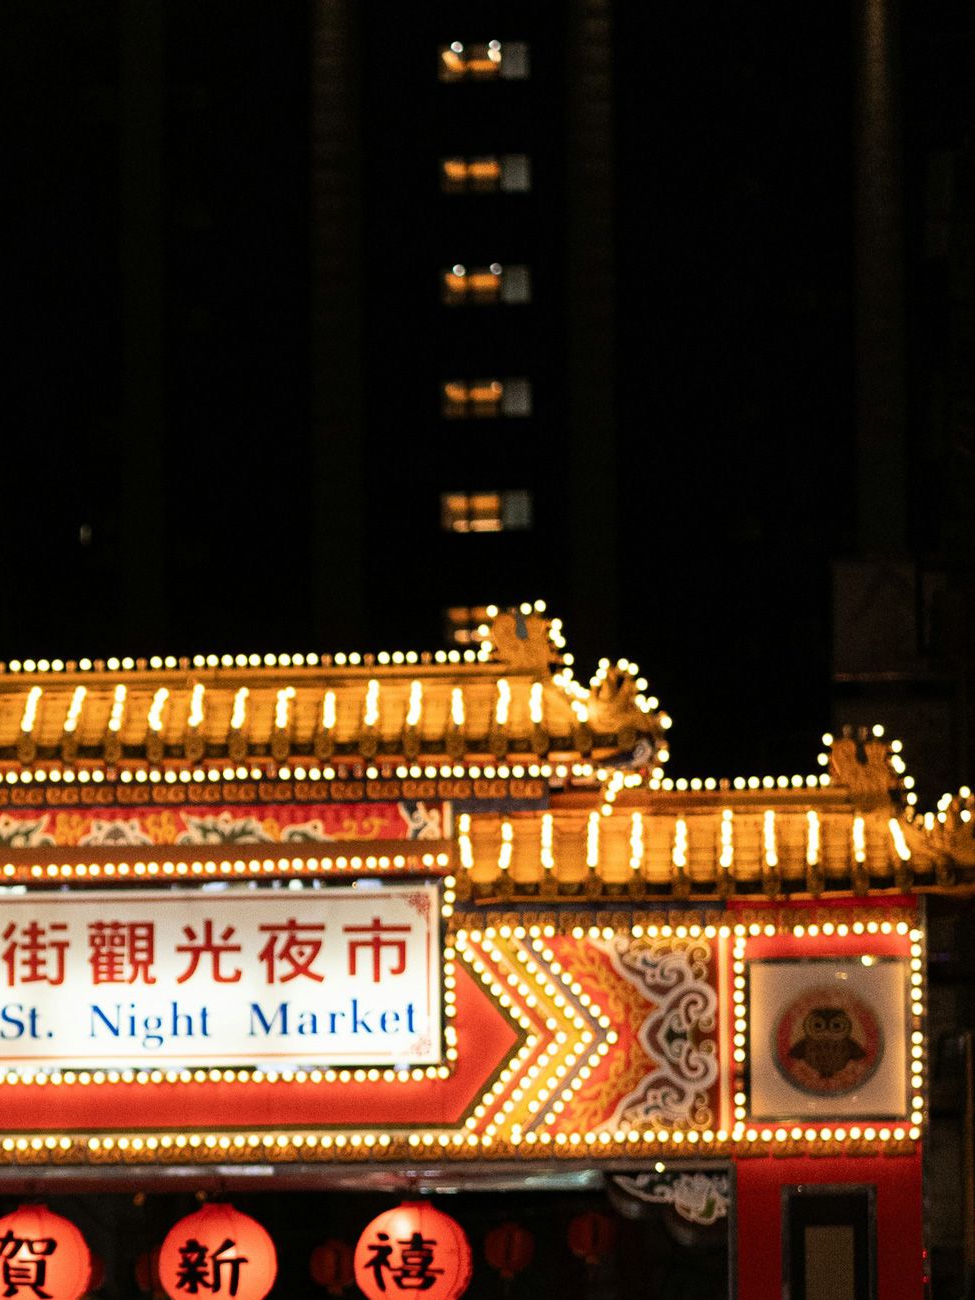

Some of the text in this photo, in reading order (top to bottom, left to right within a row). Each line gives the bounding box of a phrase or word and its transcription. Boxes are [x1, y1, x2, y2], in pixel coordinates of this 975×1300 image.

[0, 1002, 54, 1041] St.
[88, 1000, 212, 1049] Night
[248, 998, 417, 1038] Market
[175, 1238, 249, 1297] 新
[363, 1232, 446, 1293] 禧
